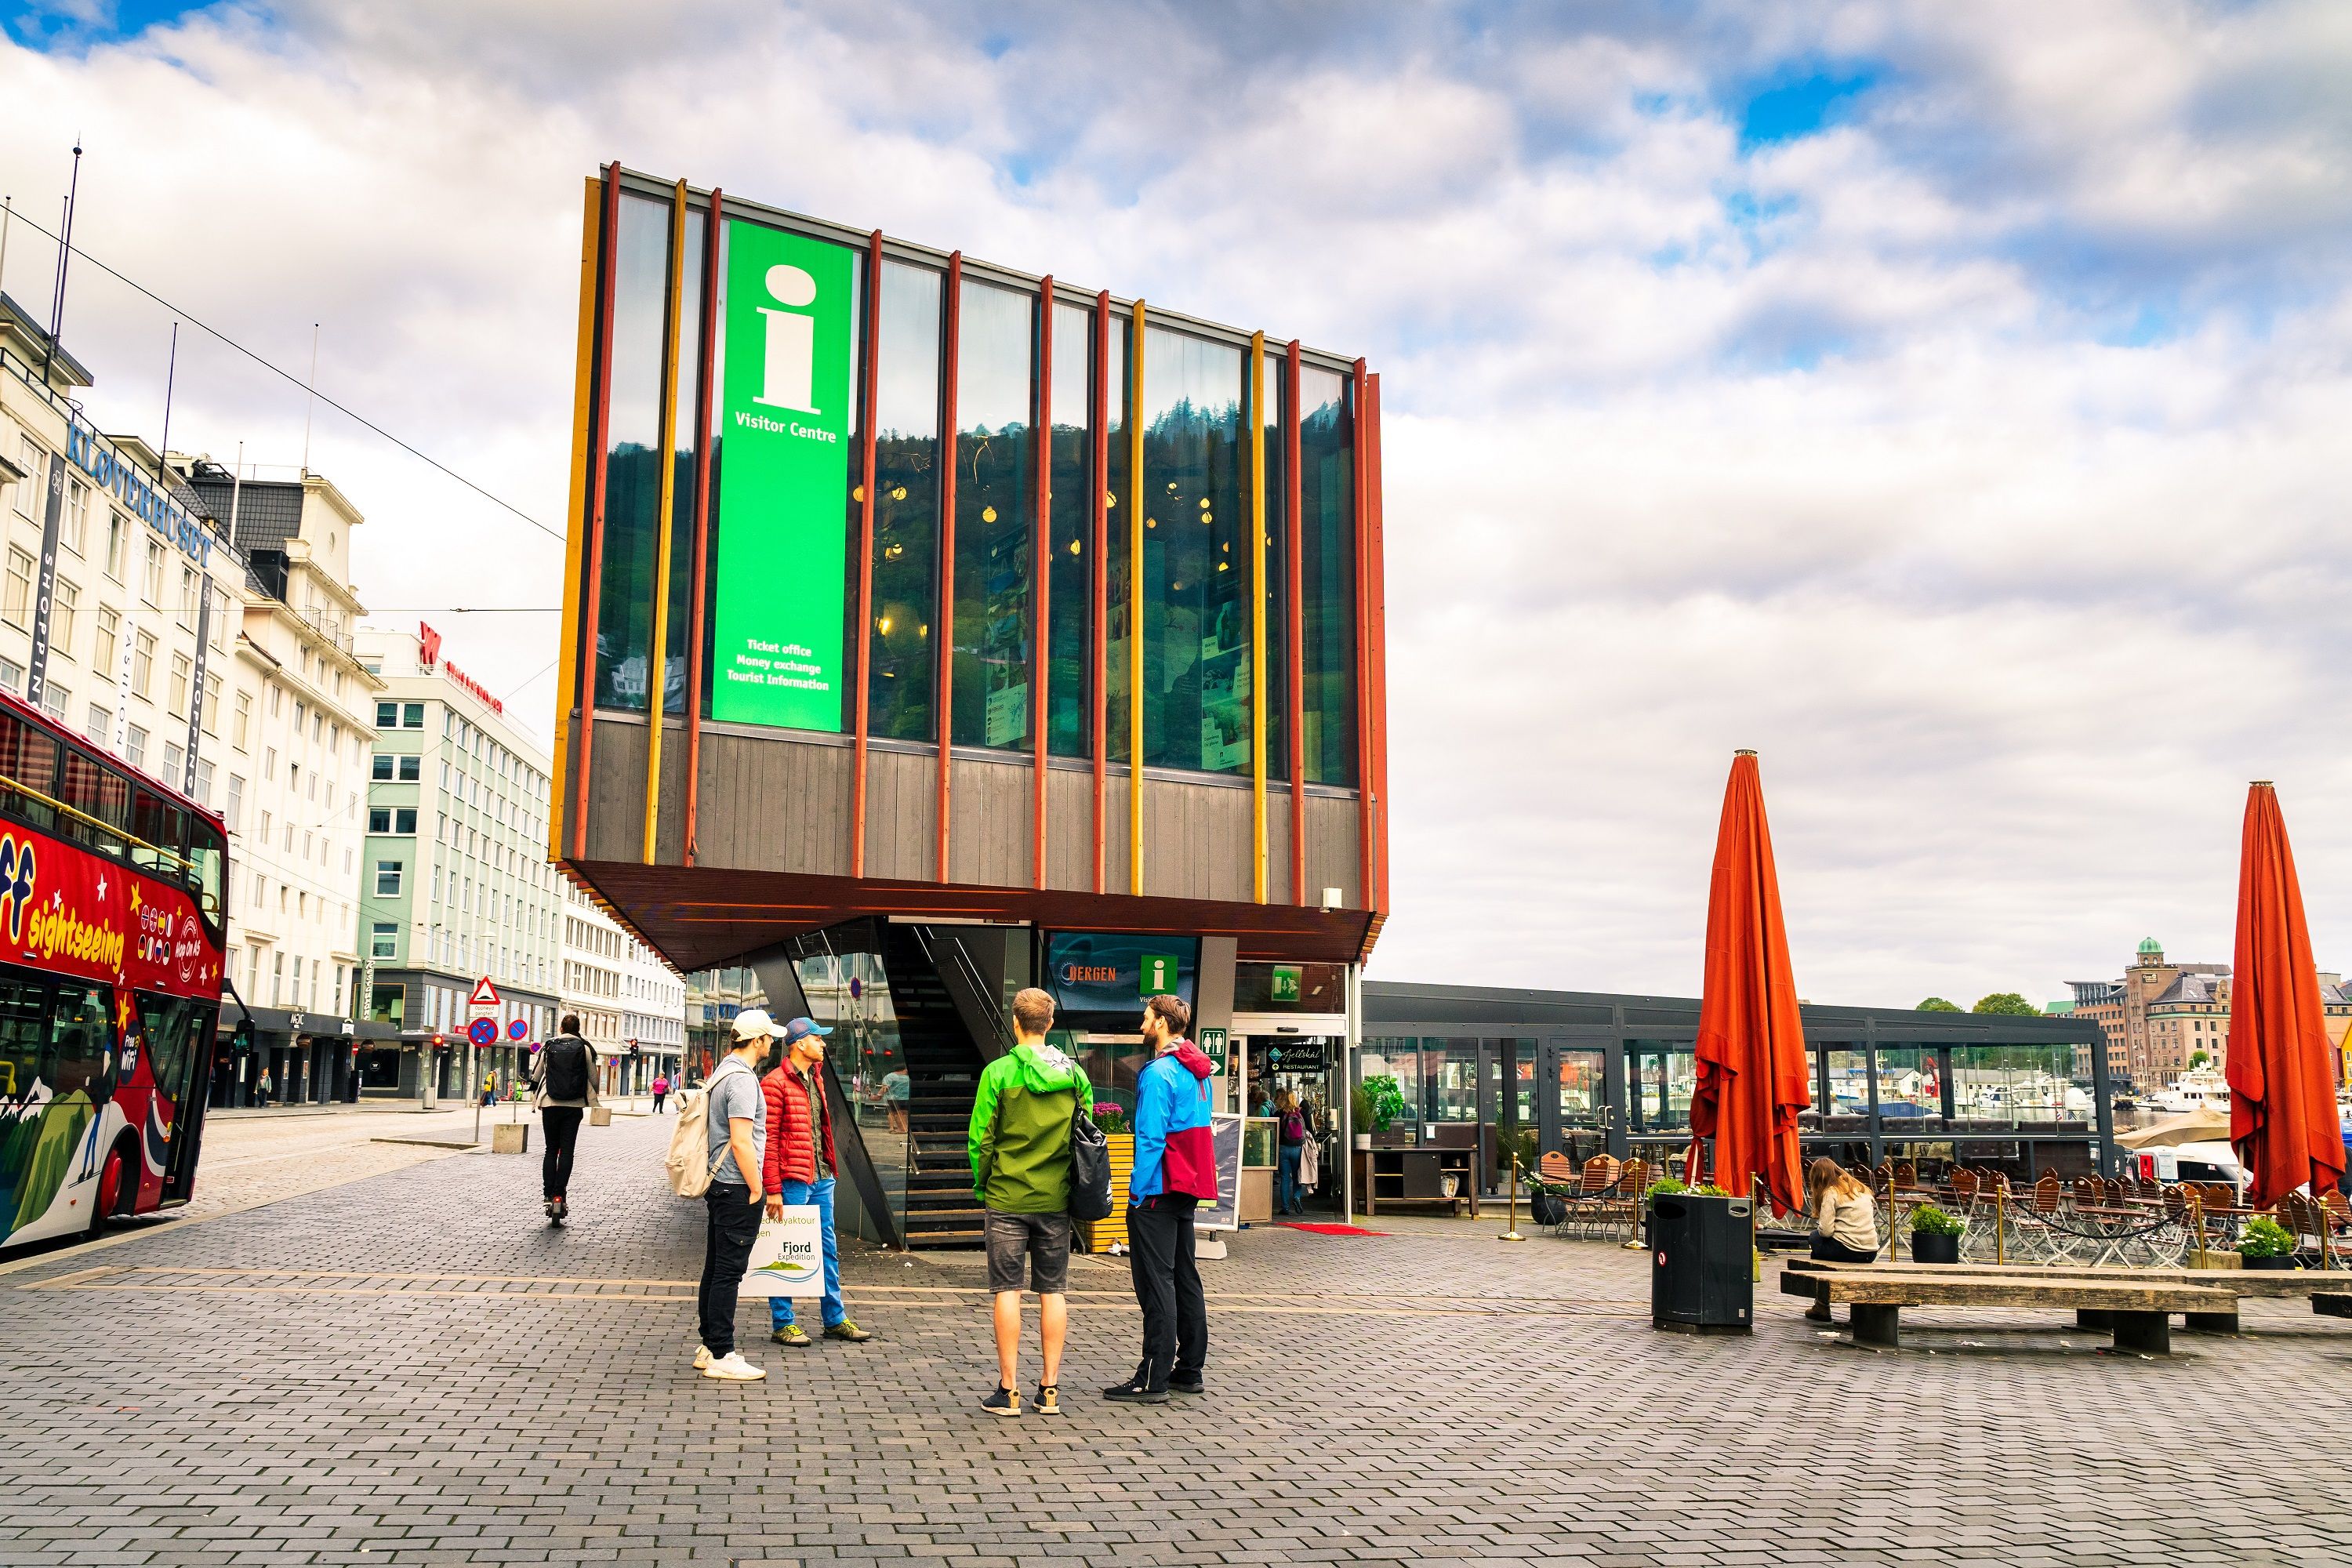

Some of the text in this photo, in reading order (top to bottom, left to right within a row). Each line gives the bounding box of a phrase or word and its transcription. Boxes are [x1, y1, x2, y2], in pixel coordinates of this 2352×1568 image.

[735, 411, 837, 443] Visitor Centre
[66, 422, 211, 568] KLØVERHUSET
[32, 553, 53, 707] SHOPPIN
[747, 639, 811, 657] Ticket office
[737, 654, 821, 676] Money exchange
[728, 669, 829, 691] Tourist Information
[28, 899, 125, 975] sightseeing
[1069, 966, 1116, 982] BERGEN
[778, 1253, 815, 1261] Expedition
[782, 1241, 811, 1255] Fjord
